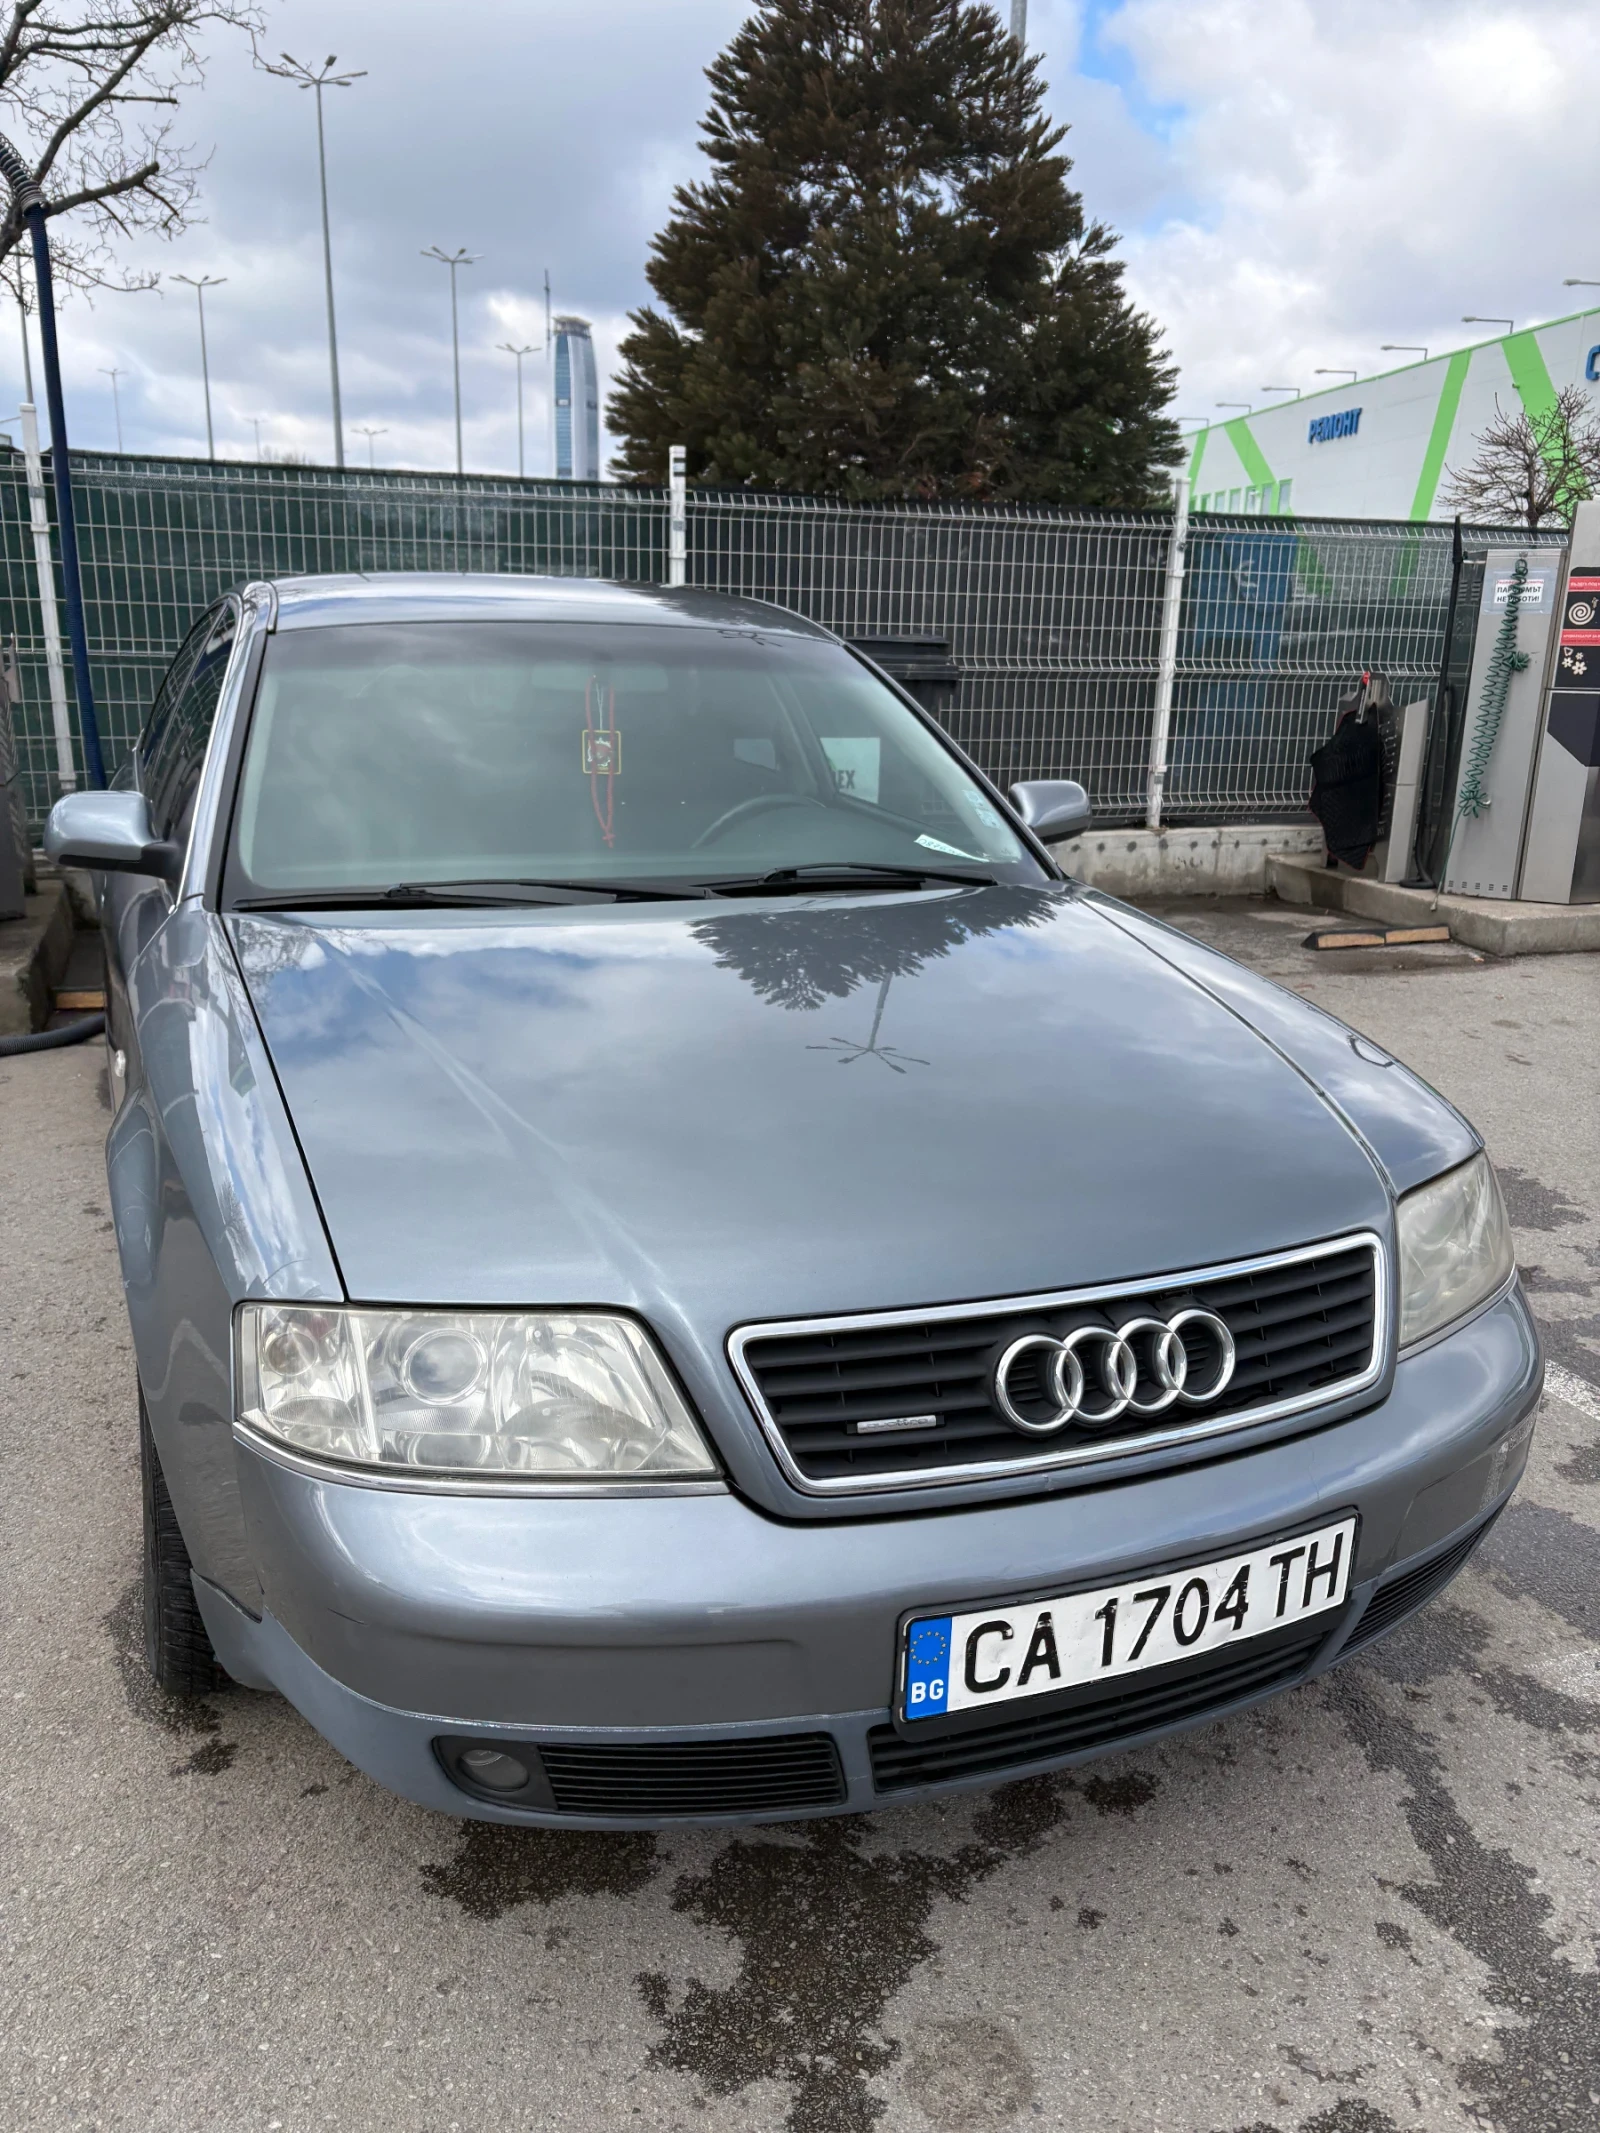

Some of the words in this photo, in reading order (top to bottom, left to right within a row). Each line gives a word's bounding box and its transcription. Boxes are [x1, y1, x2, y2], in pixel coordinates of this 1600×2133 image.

[1308, 407, 1362, 444] РЕМОНТ
[965, 1611, 1062, 1693] CA
[1095, 1564, 1250, 1667] 1704
[1269, 1531, 1343, 1618] TH
[911, 1678, 944, 1704] BG
